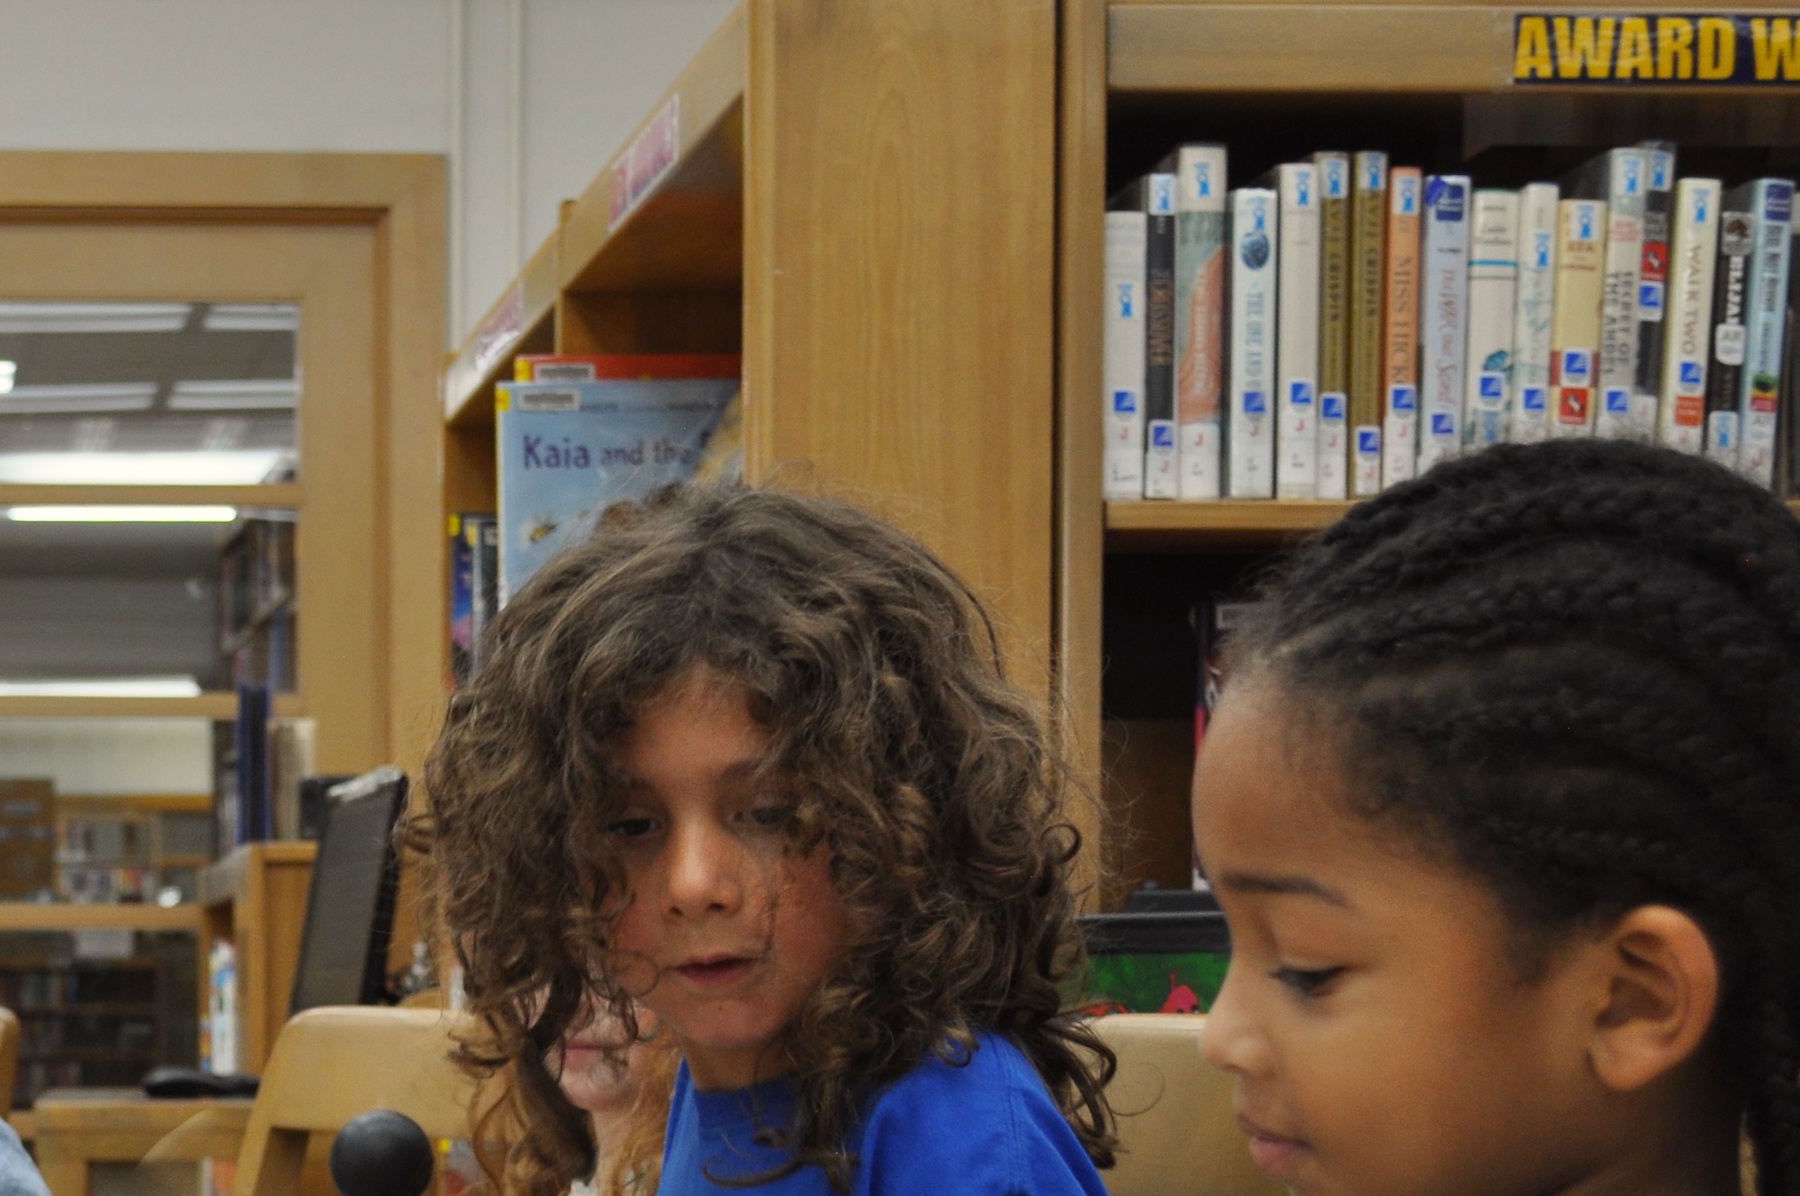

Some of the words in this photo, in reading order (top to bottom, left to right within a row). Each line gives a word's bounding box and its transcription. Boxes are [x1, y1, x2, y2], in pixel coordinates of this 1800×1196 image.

[1513, 16, 1737, 80] AWARD
[1393, 257, 1412, 313] MISS
[1606, 271, 1621, 306] THE
[1391, 321, 1409, 383] HICK
[1681, 307, 1698, 355] TWO
[522, 433, 591, 470] Kaia
[601, 438, 644, 467] and
